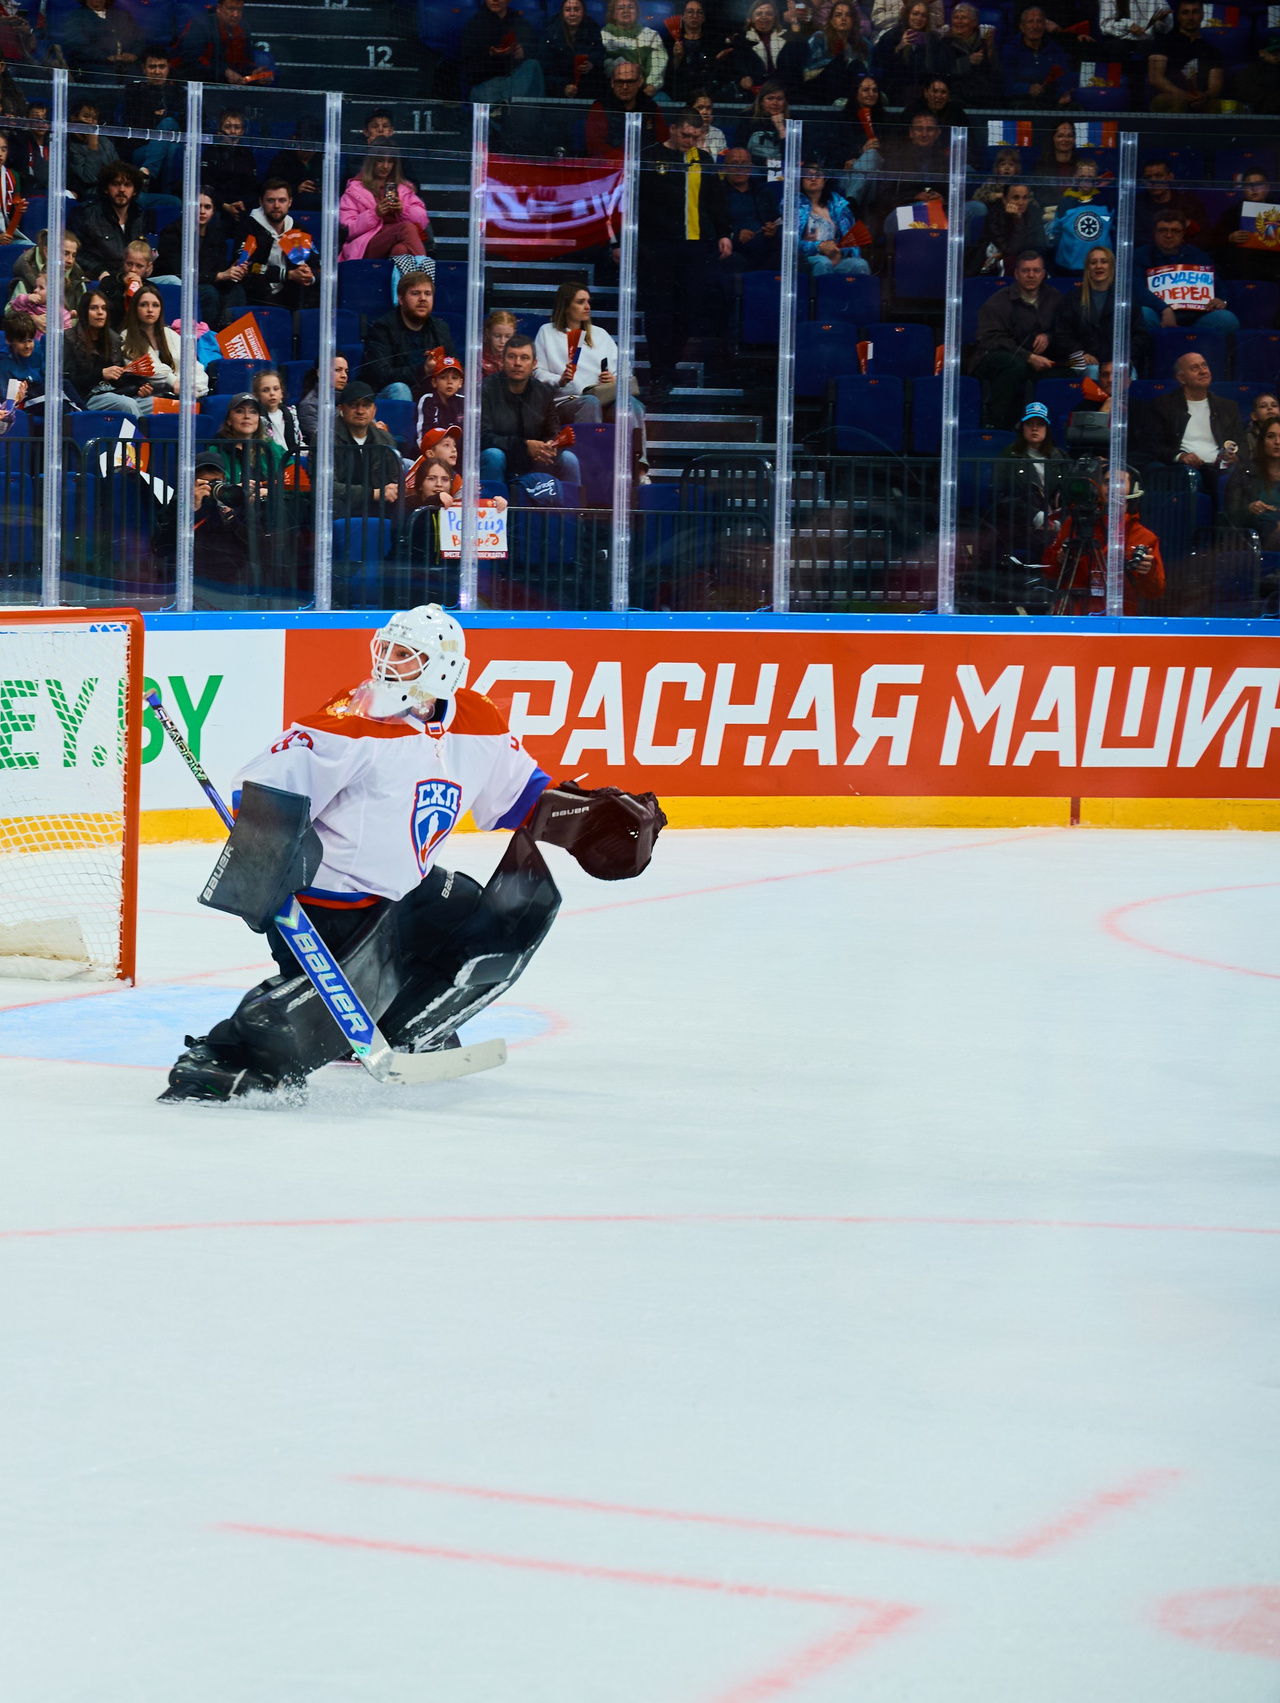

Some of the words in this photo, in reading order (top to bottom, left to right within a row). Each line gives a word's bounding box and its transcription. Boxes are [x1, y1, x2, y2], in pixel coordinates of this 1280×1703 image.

[366, 45, 394, 68] 12
[412, 110, 435, 132] 11
[470, 660, 924, 765] РАСНАЯ
[154, 707, 207, 780] SHADOW
[552, 806, 590, 818] BAUER
[202, 844, 235, 902] BAUER
[292, 932, 369, 1034] BAUER
